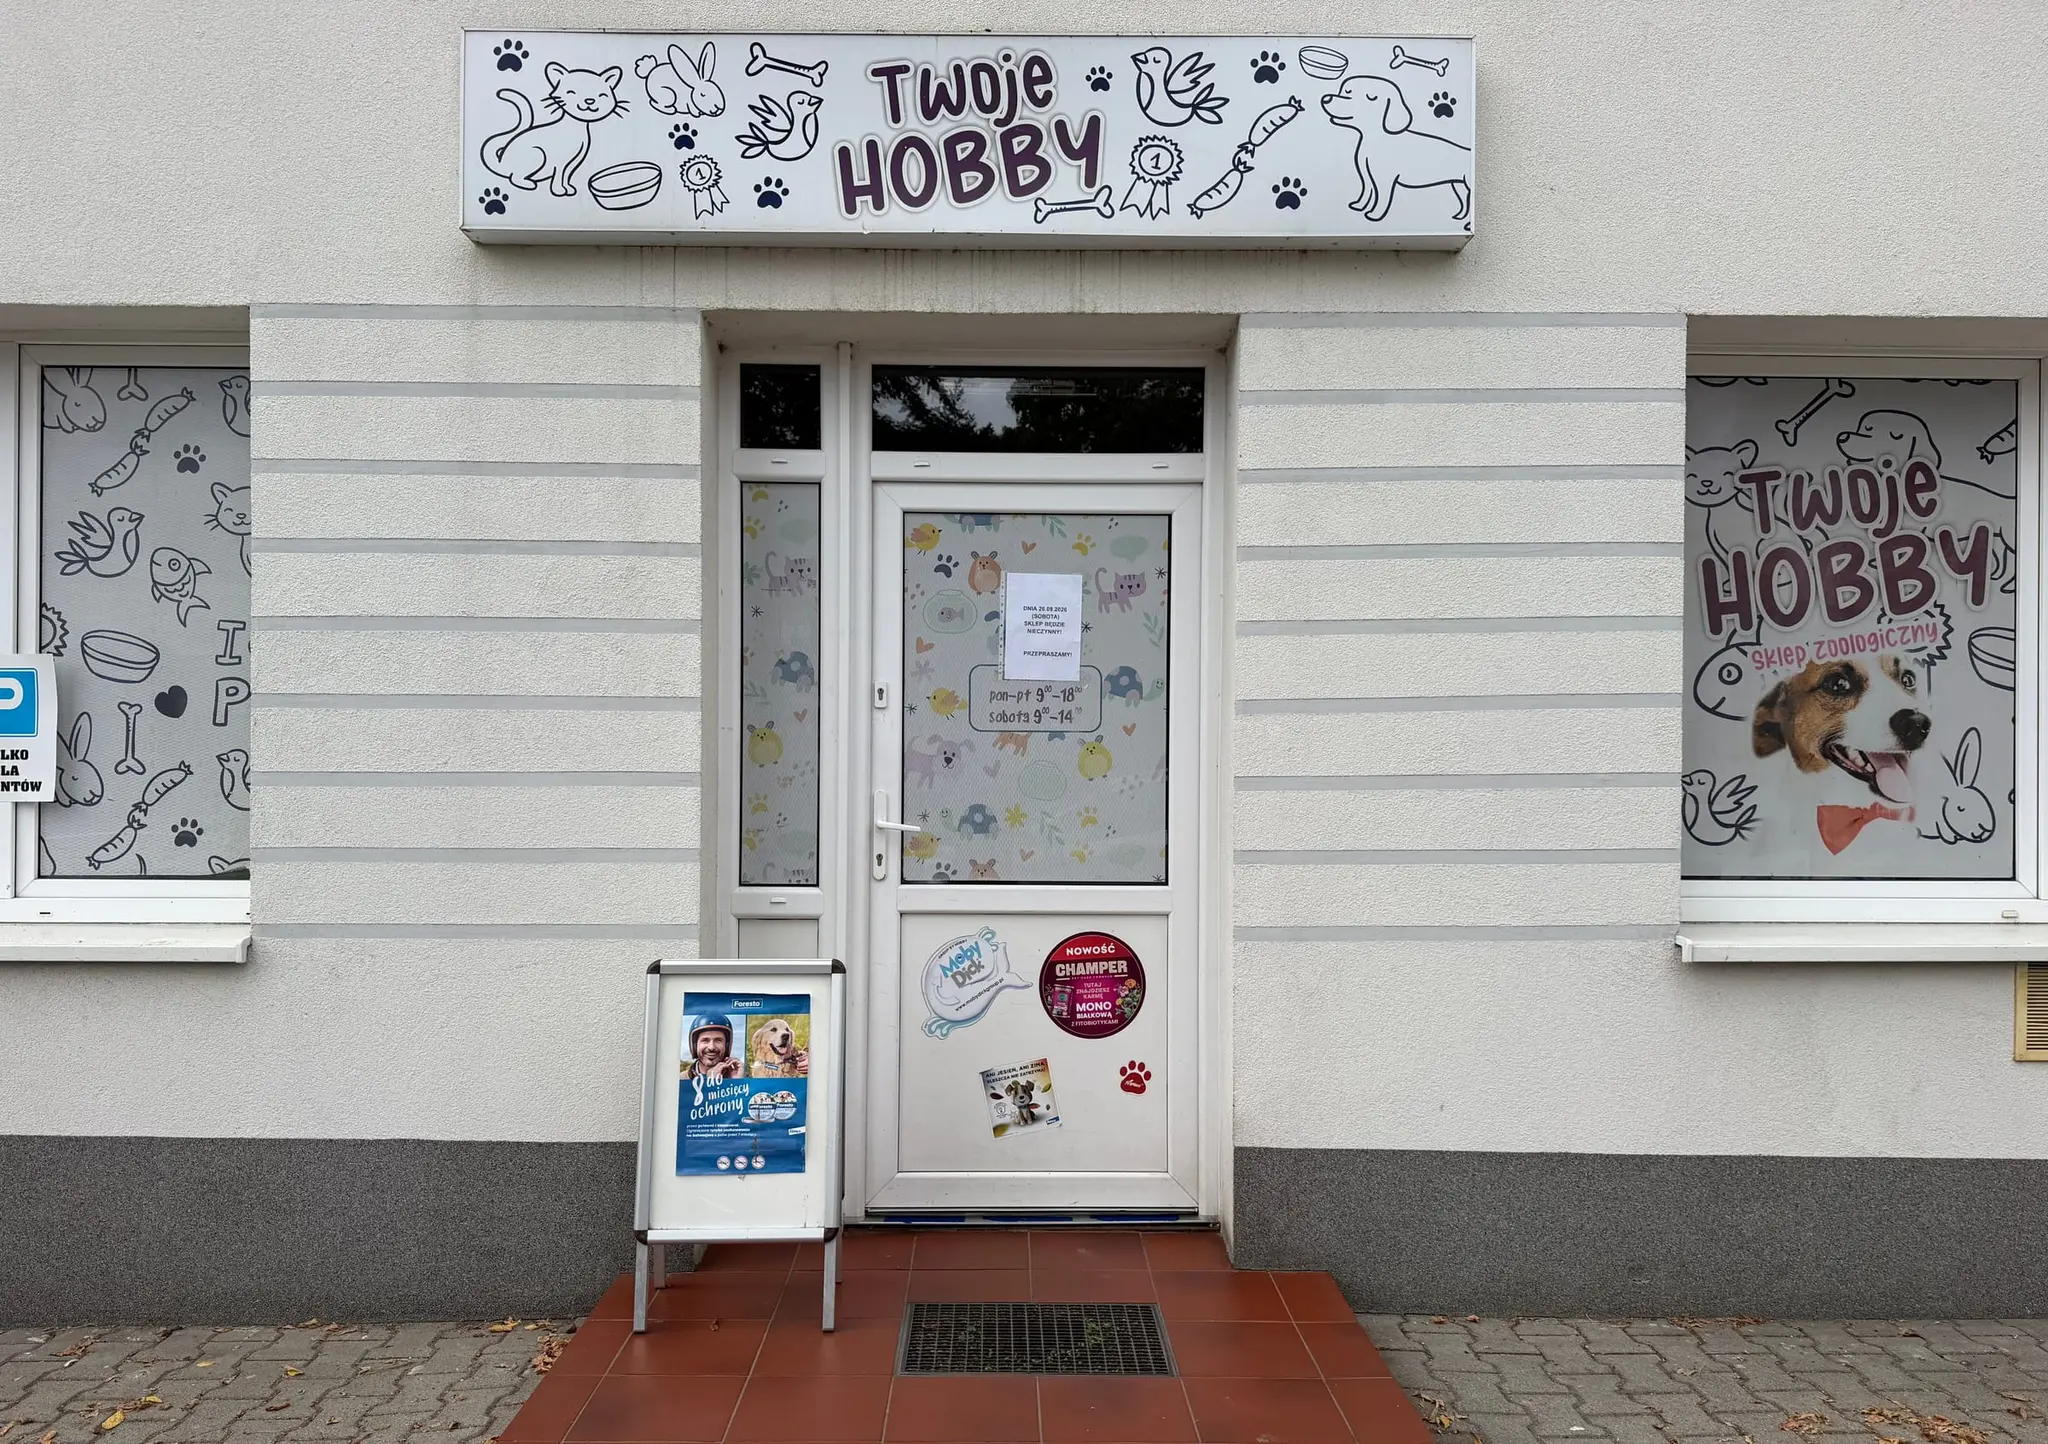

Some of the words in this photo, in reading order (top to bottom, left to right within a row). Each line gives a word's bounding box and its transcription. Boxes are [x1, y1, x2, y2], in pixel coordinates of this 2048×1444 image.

[837, 114, 1101, 216] HOBBY
[1149, 152, 1162, 170] 1
[695, 167, 707, 180] 1
[1700, 525, 1990, 636] HOBBY
[1023, 650, 1072, 658] PRZEPRASZAMY!
[989, 709, 1030, 723] sobota
[1066, 943, 1115, 956] NOWOŚĆ
[939, 941, 982, 978] Moby
[950, 958, 985, 988] Dick
[1055, 960, 1128, 977] CHAMPER
[1076, 1001, 1112, 1012] MONO
[1076, 1011, 1113, 1019] BIAŁKOWĄ
[692, 1073, 705, 1107] 8
[706, 1070, 723, 1087] do
[708, 1083, 749, 1100] miesięcy
[690, 1097, 744, 1120] ochrony
